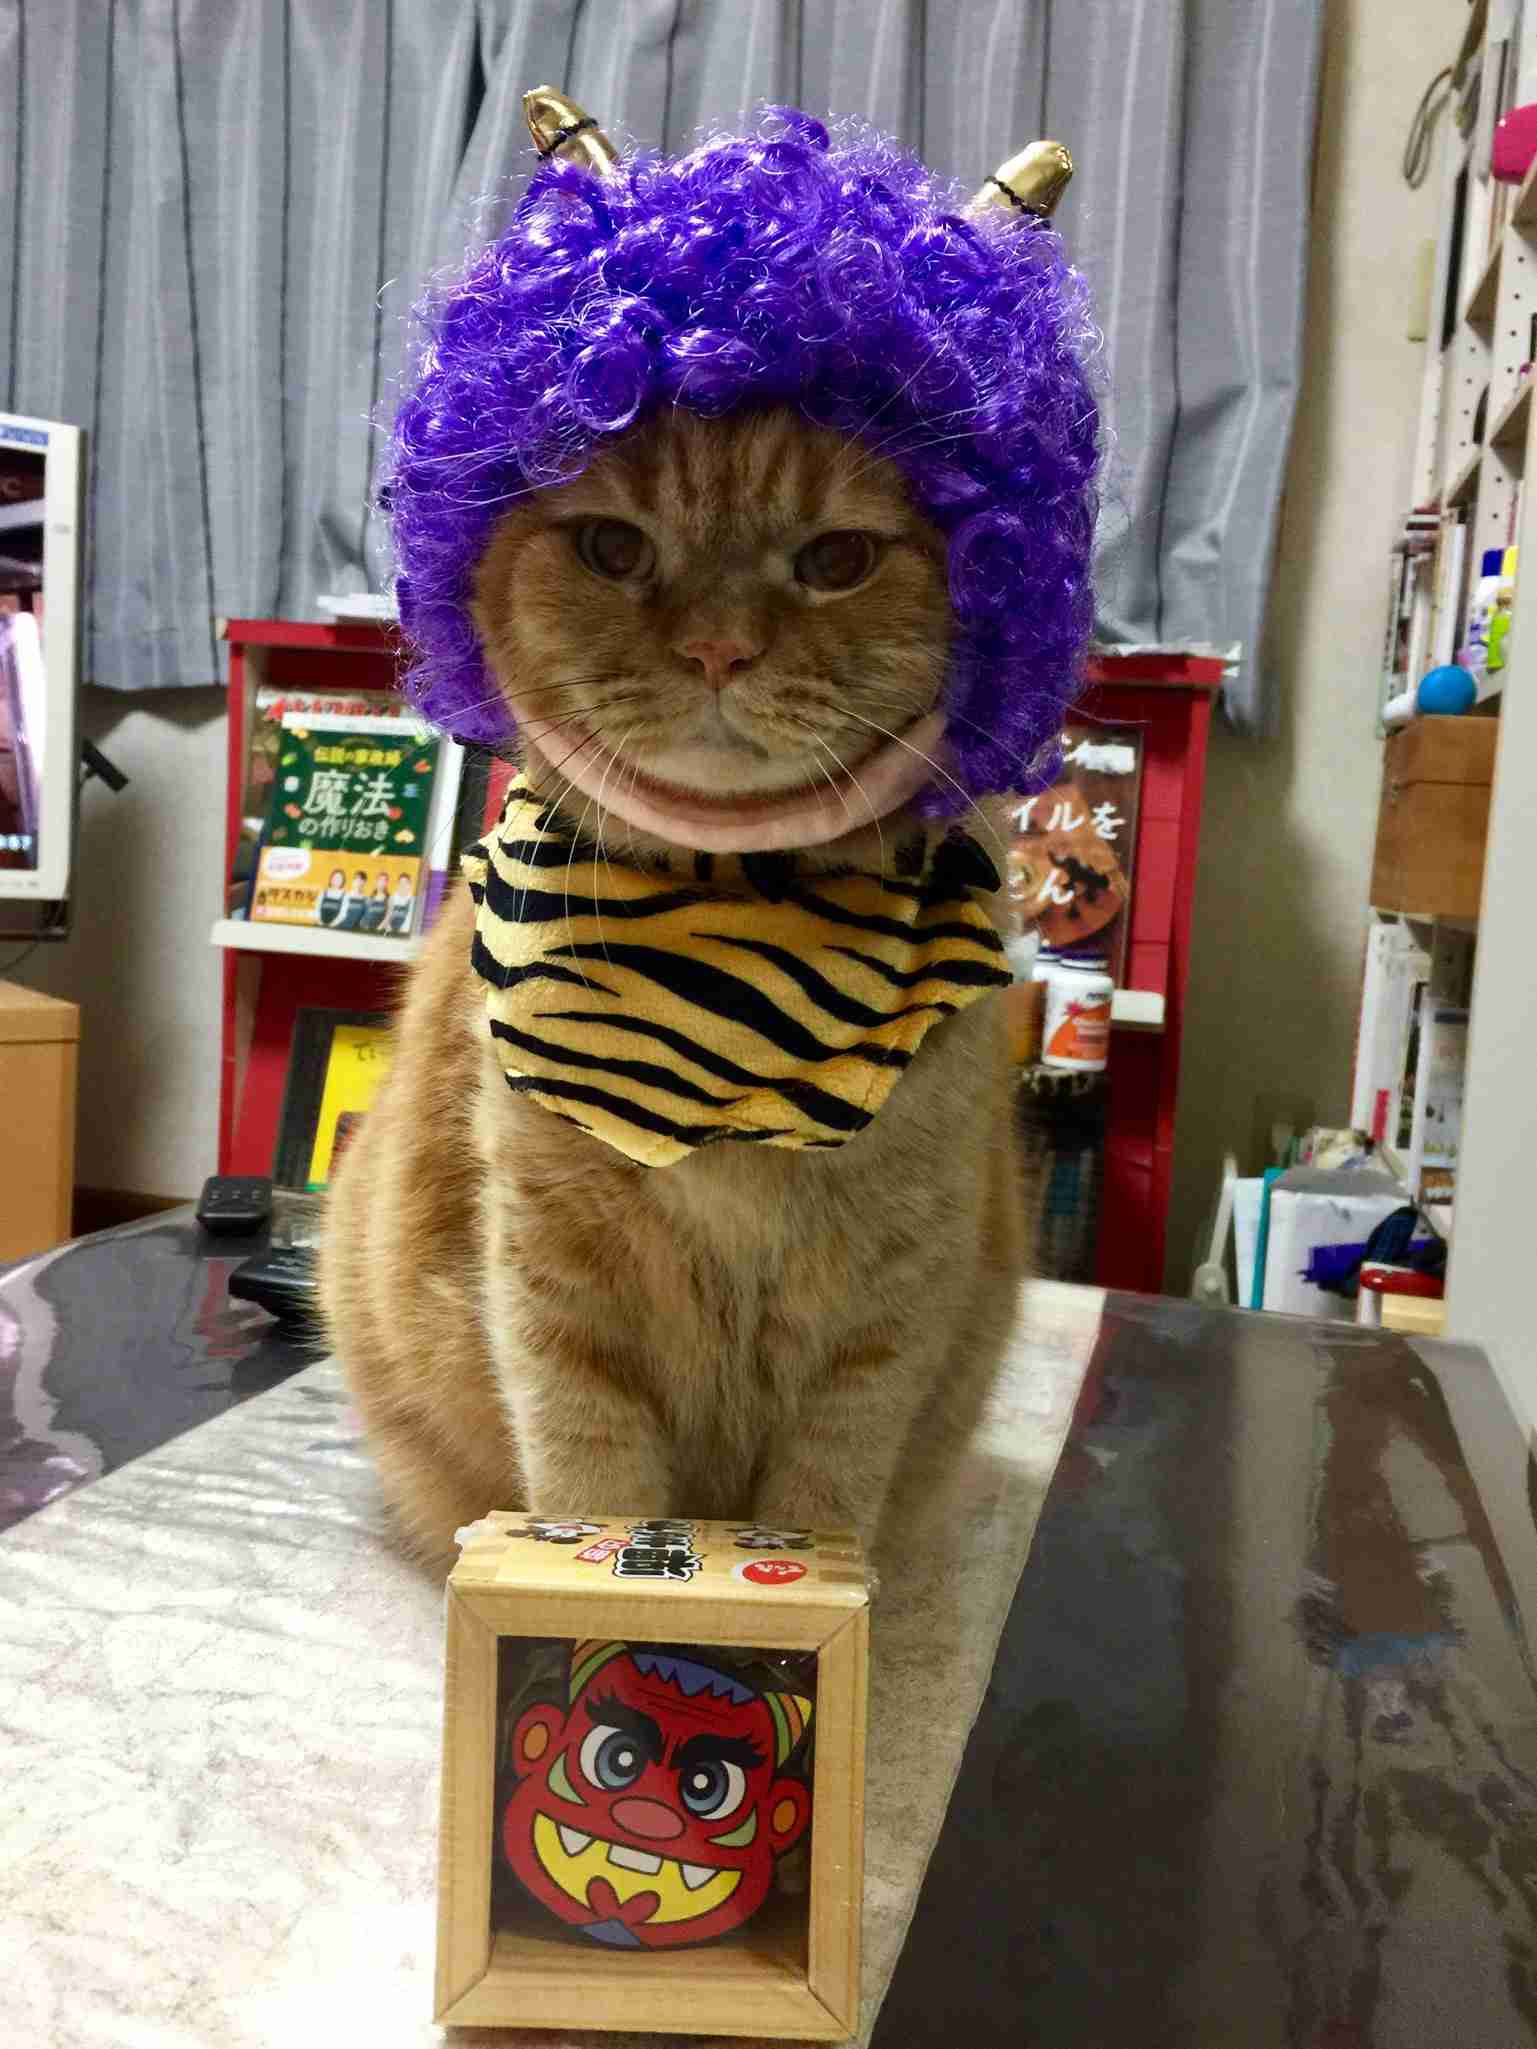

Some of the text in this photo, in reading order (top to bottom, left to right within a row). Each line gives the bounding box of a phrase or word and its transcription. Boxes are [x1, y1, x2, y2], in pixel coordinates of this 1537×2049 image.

[302, 769, 396, 817] 魔法
[299, 816, 390, 842] の作りおき
